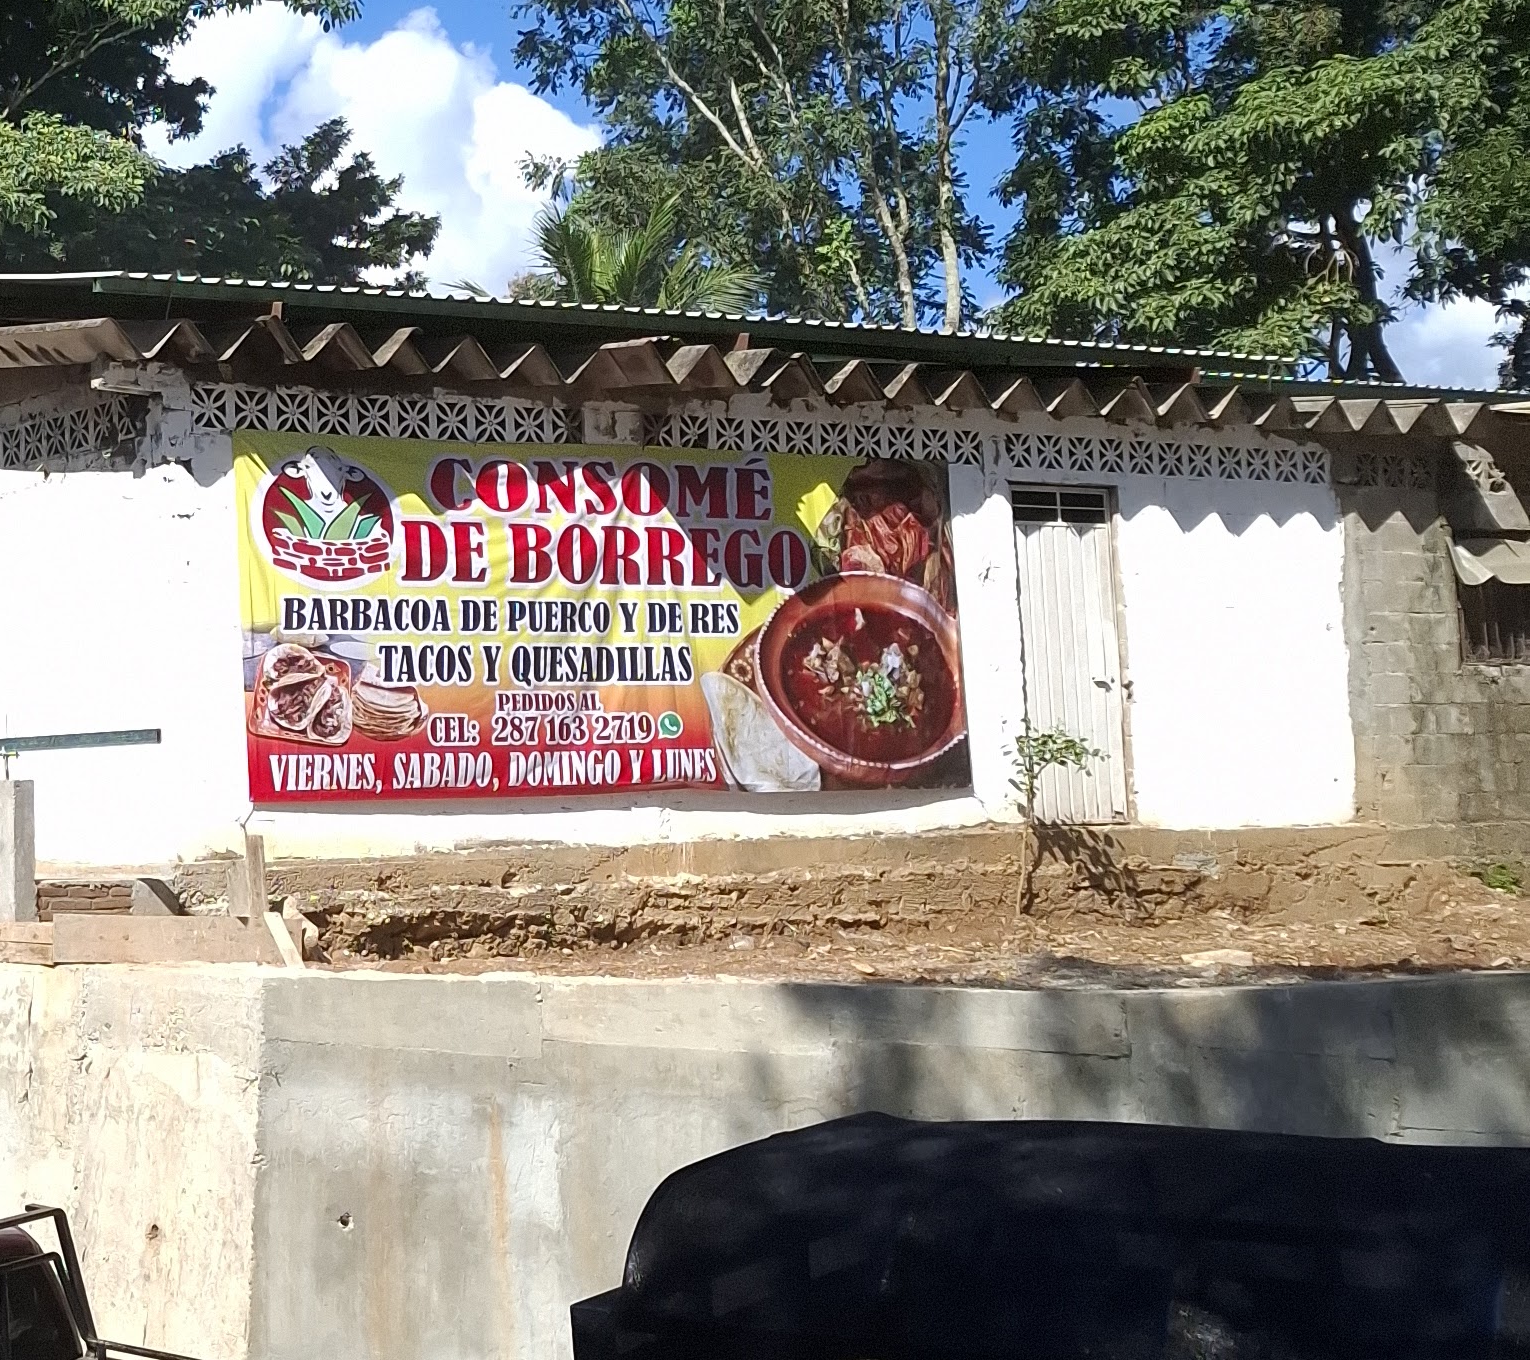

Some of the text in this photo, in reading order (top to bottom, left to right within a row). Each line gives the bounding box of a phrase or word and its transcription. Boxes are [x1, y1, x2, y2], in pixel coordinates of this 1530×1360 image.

[430, 458, 772, 521] CONSOMÉ
[401, 519, 807, 588] DE BORREGO
[283, 598, 739, 634] BARBACOA DE PUERCO Y DE RES
[378, 645, 693, 687] TACOS Y QUESADILLAS
[497, 693, 601, 712] PEDIDOS AL
[429, 715, 653, 743] CEL: 287 163 2719
[269, 748, 716, 794] VIERNES, SABADO, DOMINGO Y LUNES
